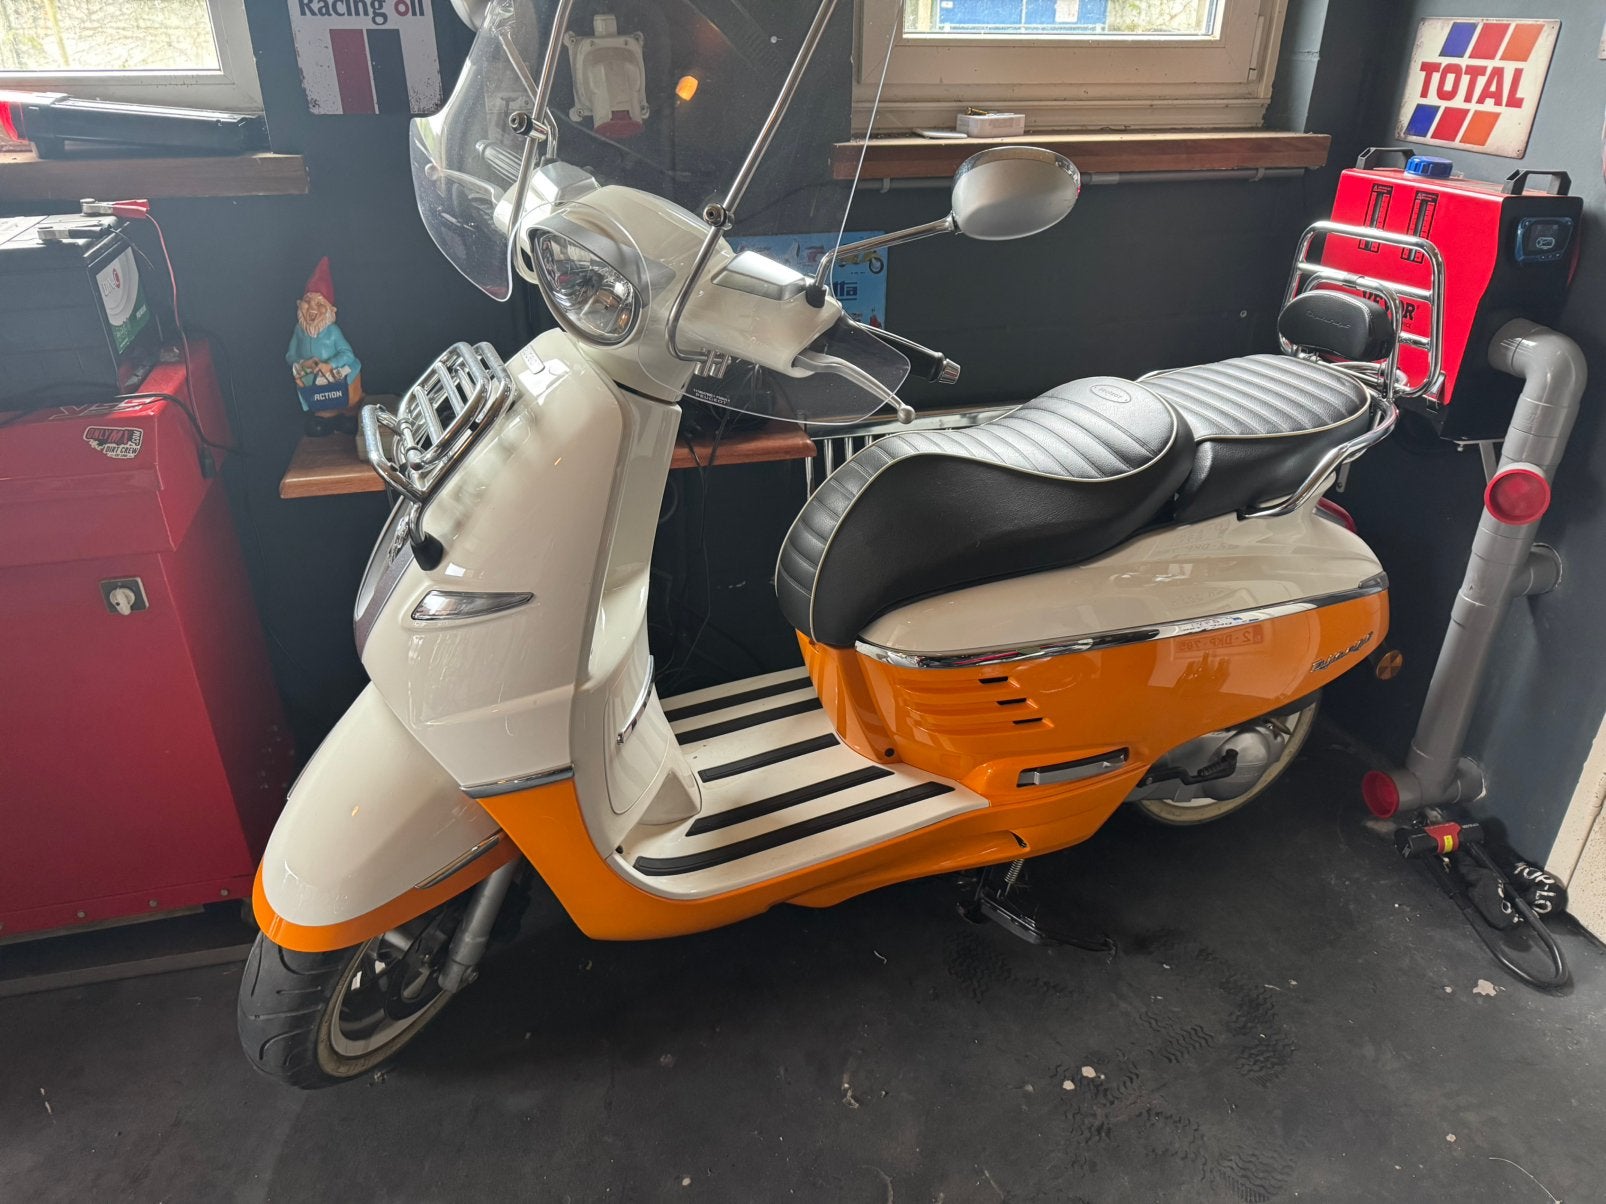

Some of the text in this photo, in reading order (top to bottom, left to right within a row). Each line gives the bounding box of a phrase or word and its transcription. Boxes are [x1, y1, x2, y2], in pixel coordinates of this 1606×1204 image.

[300, 0, 388, 25] Racing
[1420, 61, 1525, 109] TOTAL
[314, 391, 342, 401] ACTION
[105, 446, 139, 455] DIRT CREW
